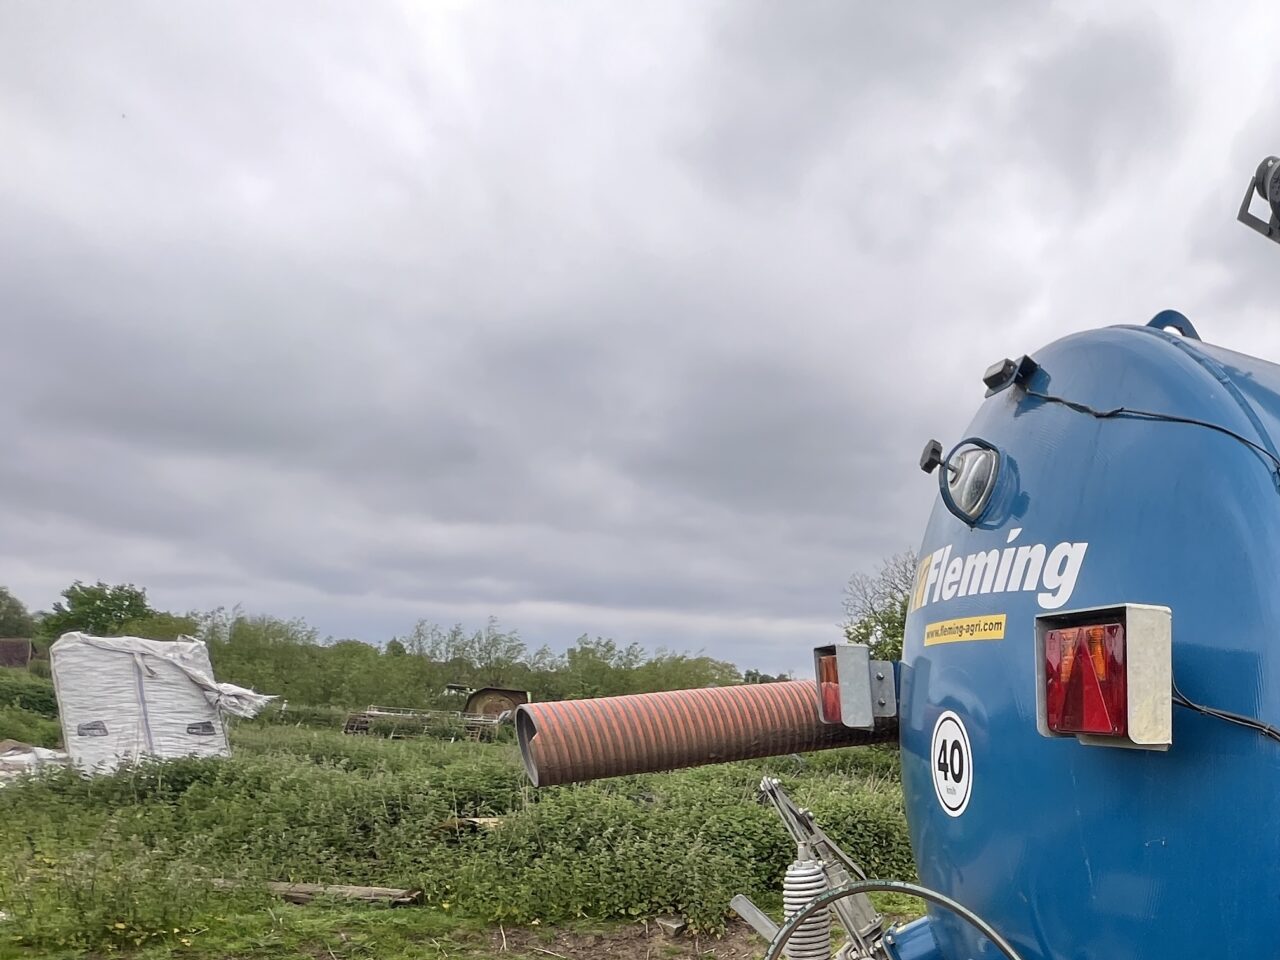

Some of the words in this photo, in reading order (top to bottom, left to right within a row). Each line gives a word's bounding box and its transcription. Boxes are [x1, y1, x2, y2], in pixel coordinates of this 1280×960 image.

[921, 528, 1088, 609] Fleming
[926, 620, 1003, 638] www.fleming-agri.com
[938, 739, 964, 783] 40
